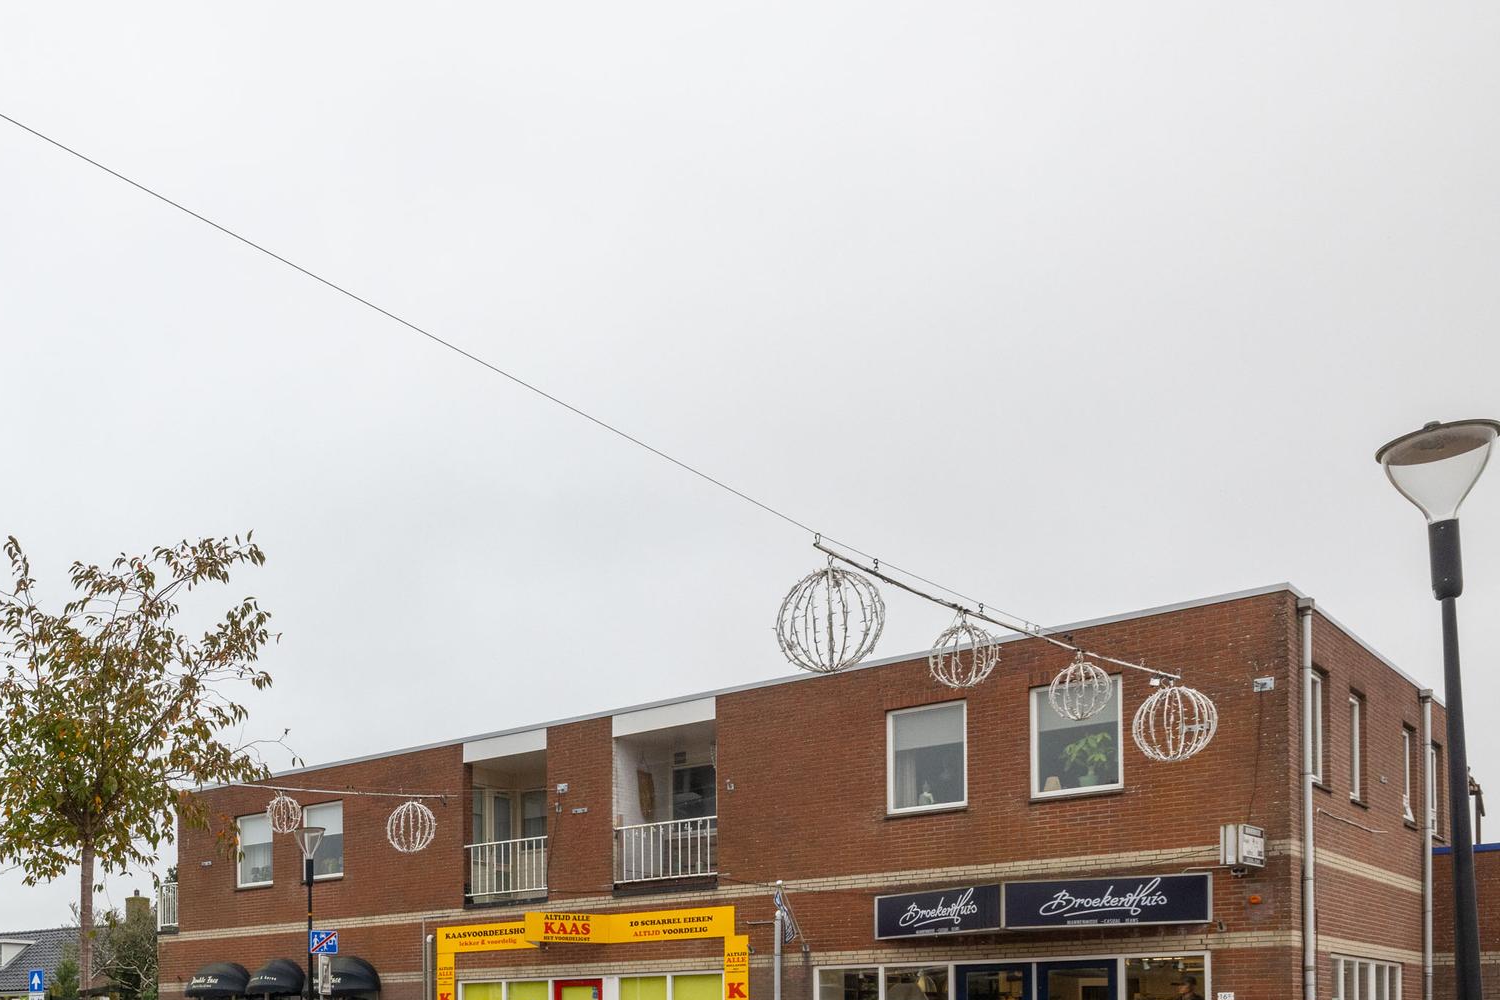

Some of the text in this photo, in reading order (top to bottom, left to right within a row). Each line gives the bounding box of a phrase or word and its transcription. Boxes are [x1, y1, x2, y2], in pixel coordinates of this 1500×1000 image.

[640, 917, 682, 926] SCHARREL
[683, 915, 714, 924] EIEREN
[445, 927, 526, 940] KAASVOORDEELSHO
[543, 922, 591, 935] KAAS
[632, 926, 708, 937] ALTIJD VOORDELIG
[487, 937, 517, 946] voordelig
